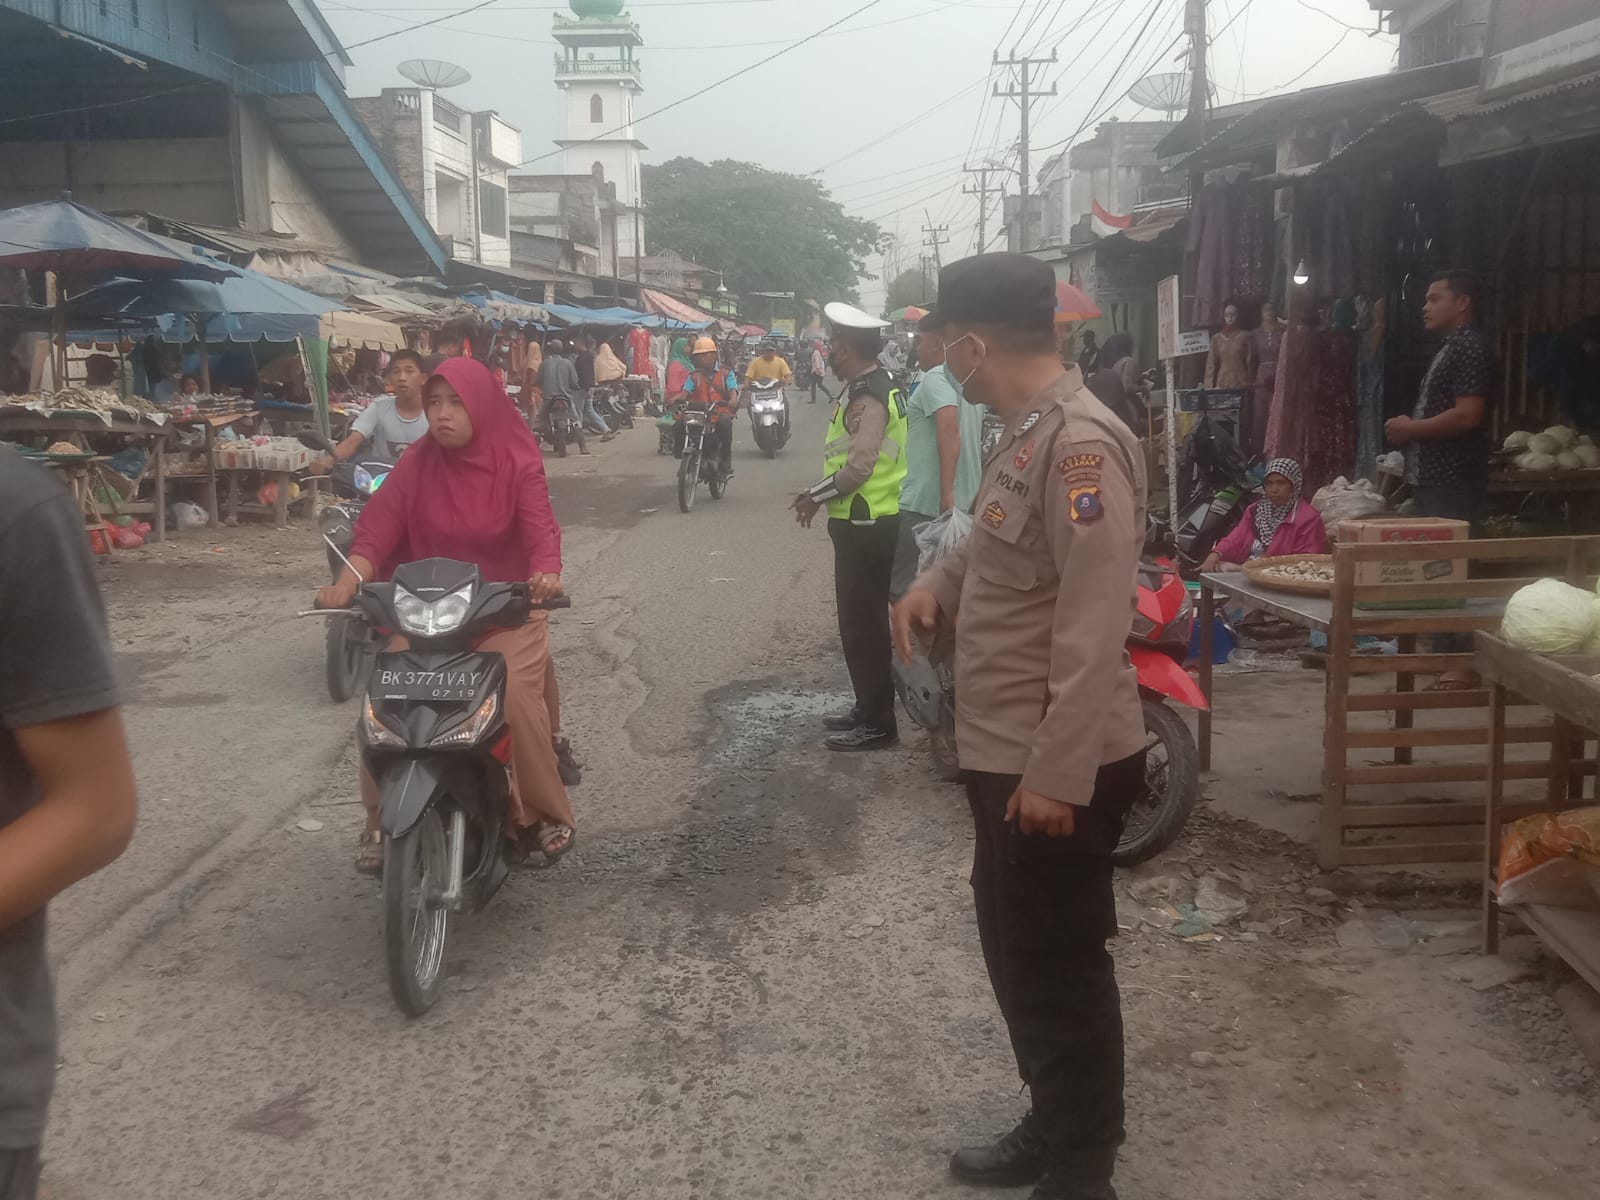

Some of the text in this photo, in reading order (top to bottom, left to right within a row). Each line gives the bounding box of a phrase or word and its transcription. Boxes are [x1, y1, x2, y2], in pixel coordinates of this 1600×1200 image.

[995, 470, 1030, 499] POLRI
[381, 670, 482, 686] BK 3771 VAY
[431, 689, 475, 698] 07 19
